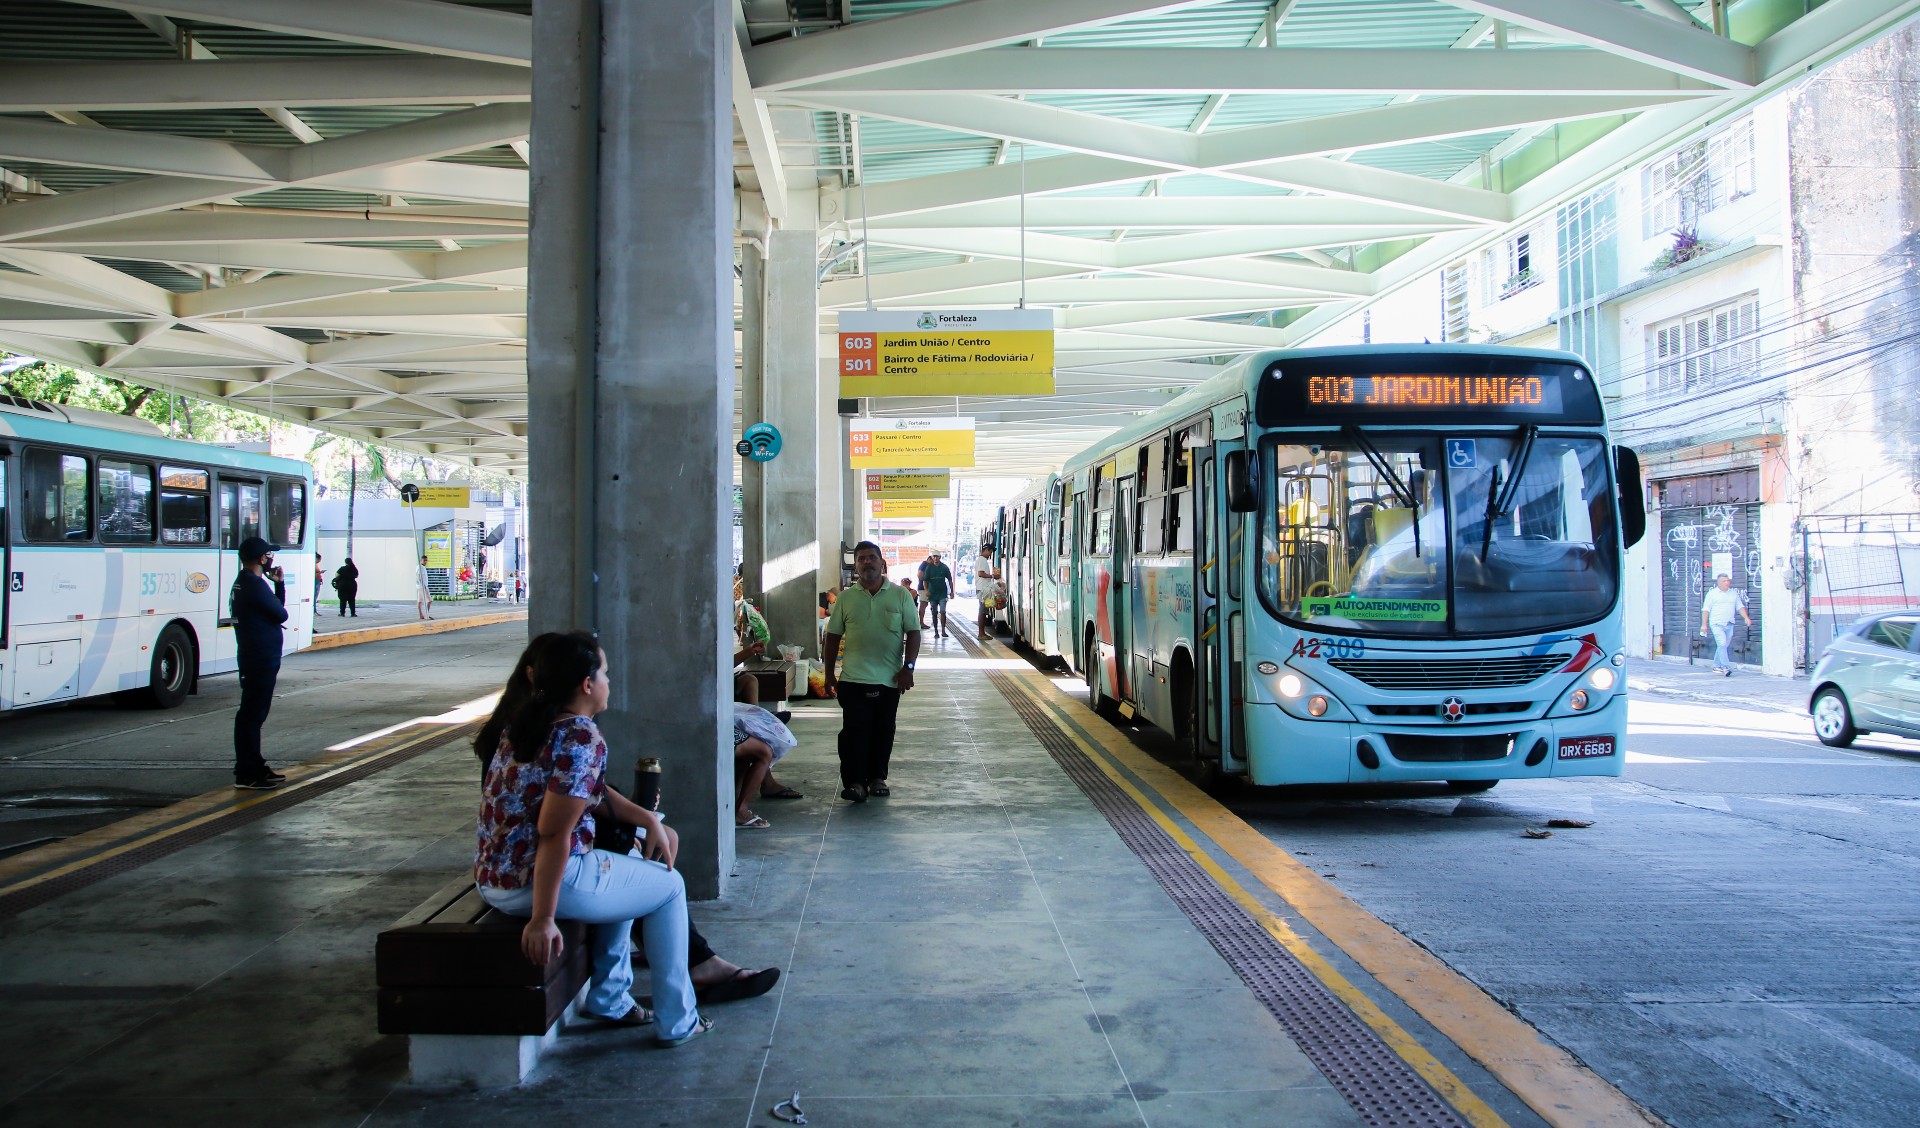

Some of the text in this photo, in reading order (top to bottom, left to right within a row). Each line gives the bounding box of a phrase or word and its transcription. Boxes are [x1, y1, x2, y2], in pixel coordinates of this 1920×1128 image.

[939, 314, 977, 323] Fortaleza
[845, 337, 873, 349] 603
[884, 338, 917, 348] Jardim
[920, 338, 949, 347] União
[957, 338, 991, 347] Centro
[884, 355, 914, 363] Bairro
[917, 354, 930, 363] de
[932, 354, 966, 363] Fátima
[975, 354, 1028, 362] Rodoviária
[845, 359, 872, 371] 501
[884, 365, 918, 374] Centro
[1309, 376, 1354, 403] 603
[1366, 376, 1460, 404] JARDIM
[853, 434, 869, 442] 633
[854, 446, 868, 454] 612
[141, 573, 177, 595] 35733
[1334, 600, 1441, 612] AUTOATENDIMENTO
[1292, 638, 1364, 658] 42309
